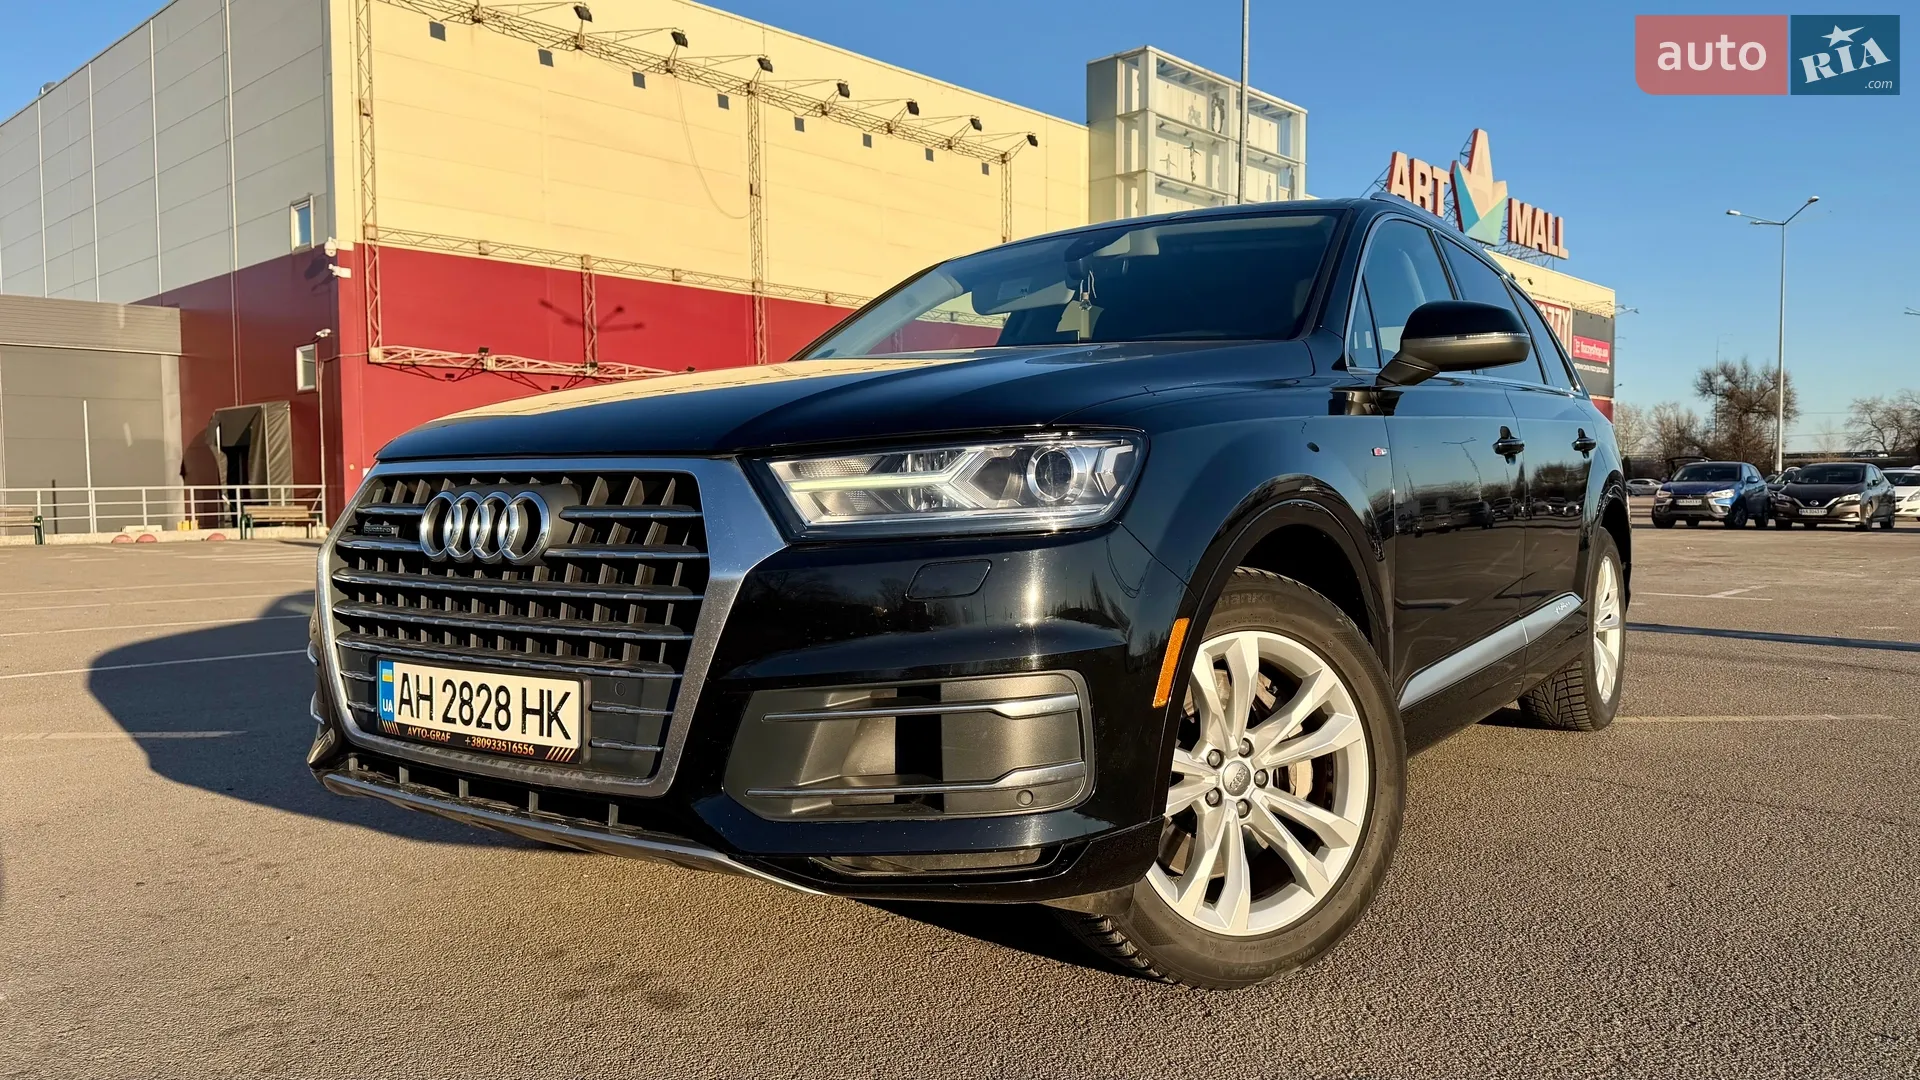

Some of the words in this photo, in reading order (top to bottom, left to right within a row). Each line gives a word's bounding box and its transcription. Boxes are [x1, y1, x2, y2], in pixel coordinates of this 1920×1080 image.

[1387, 151, 1450, 218] ART
[1507, 198, 1569, 260] MALL
[382, 699, 394, 713] UA
[398, 672, 434, 721] AH
[441, 678, 511, 731] 2828
[521, 686, 571, 740] HK
[465, 736, 535, 756] +380933516556
